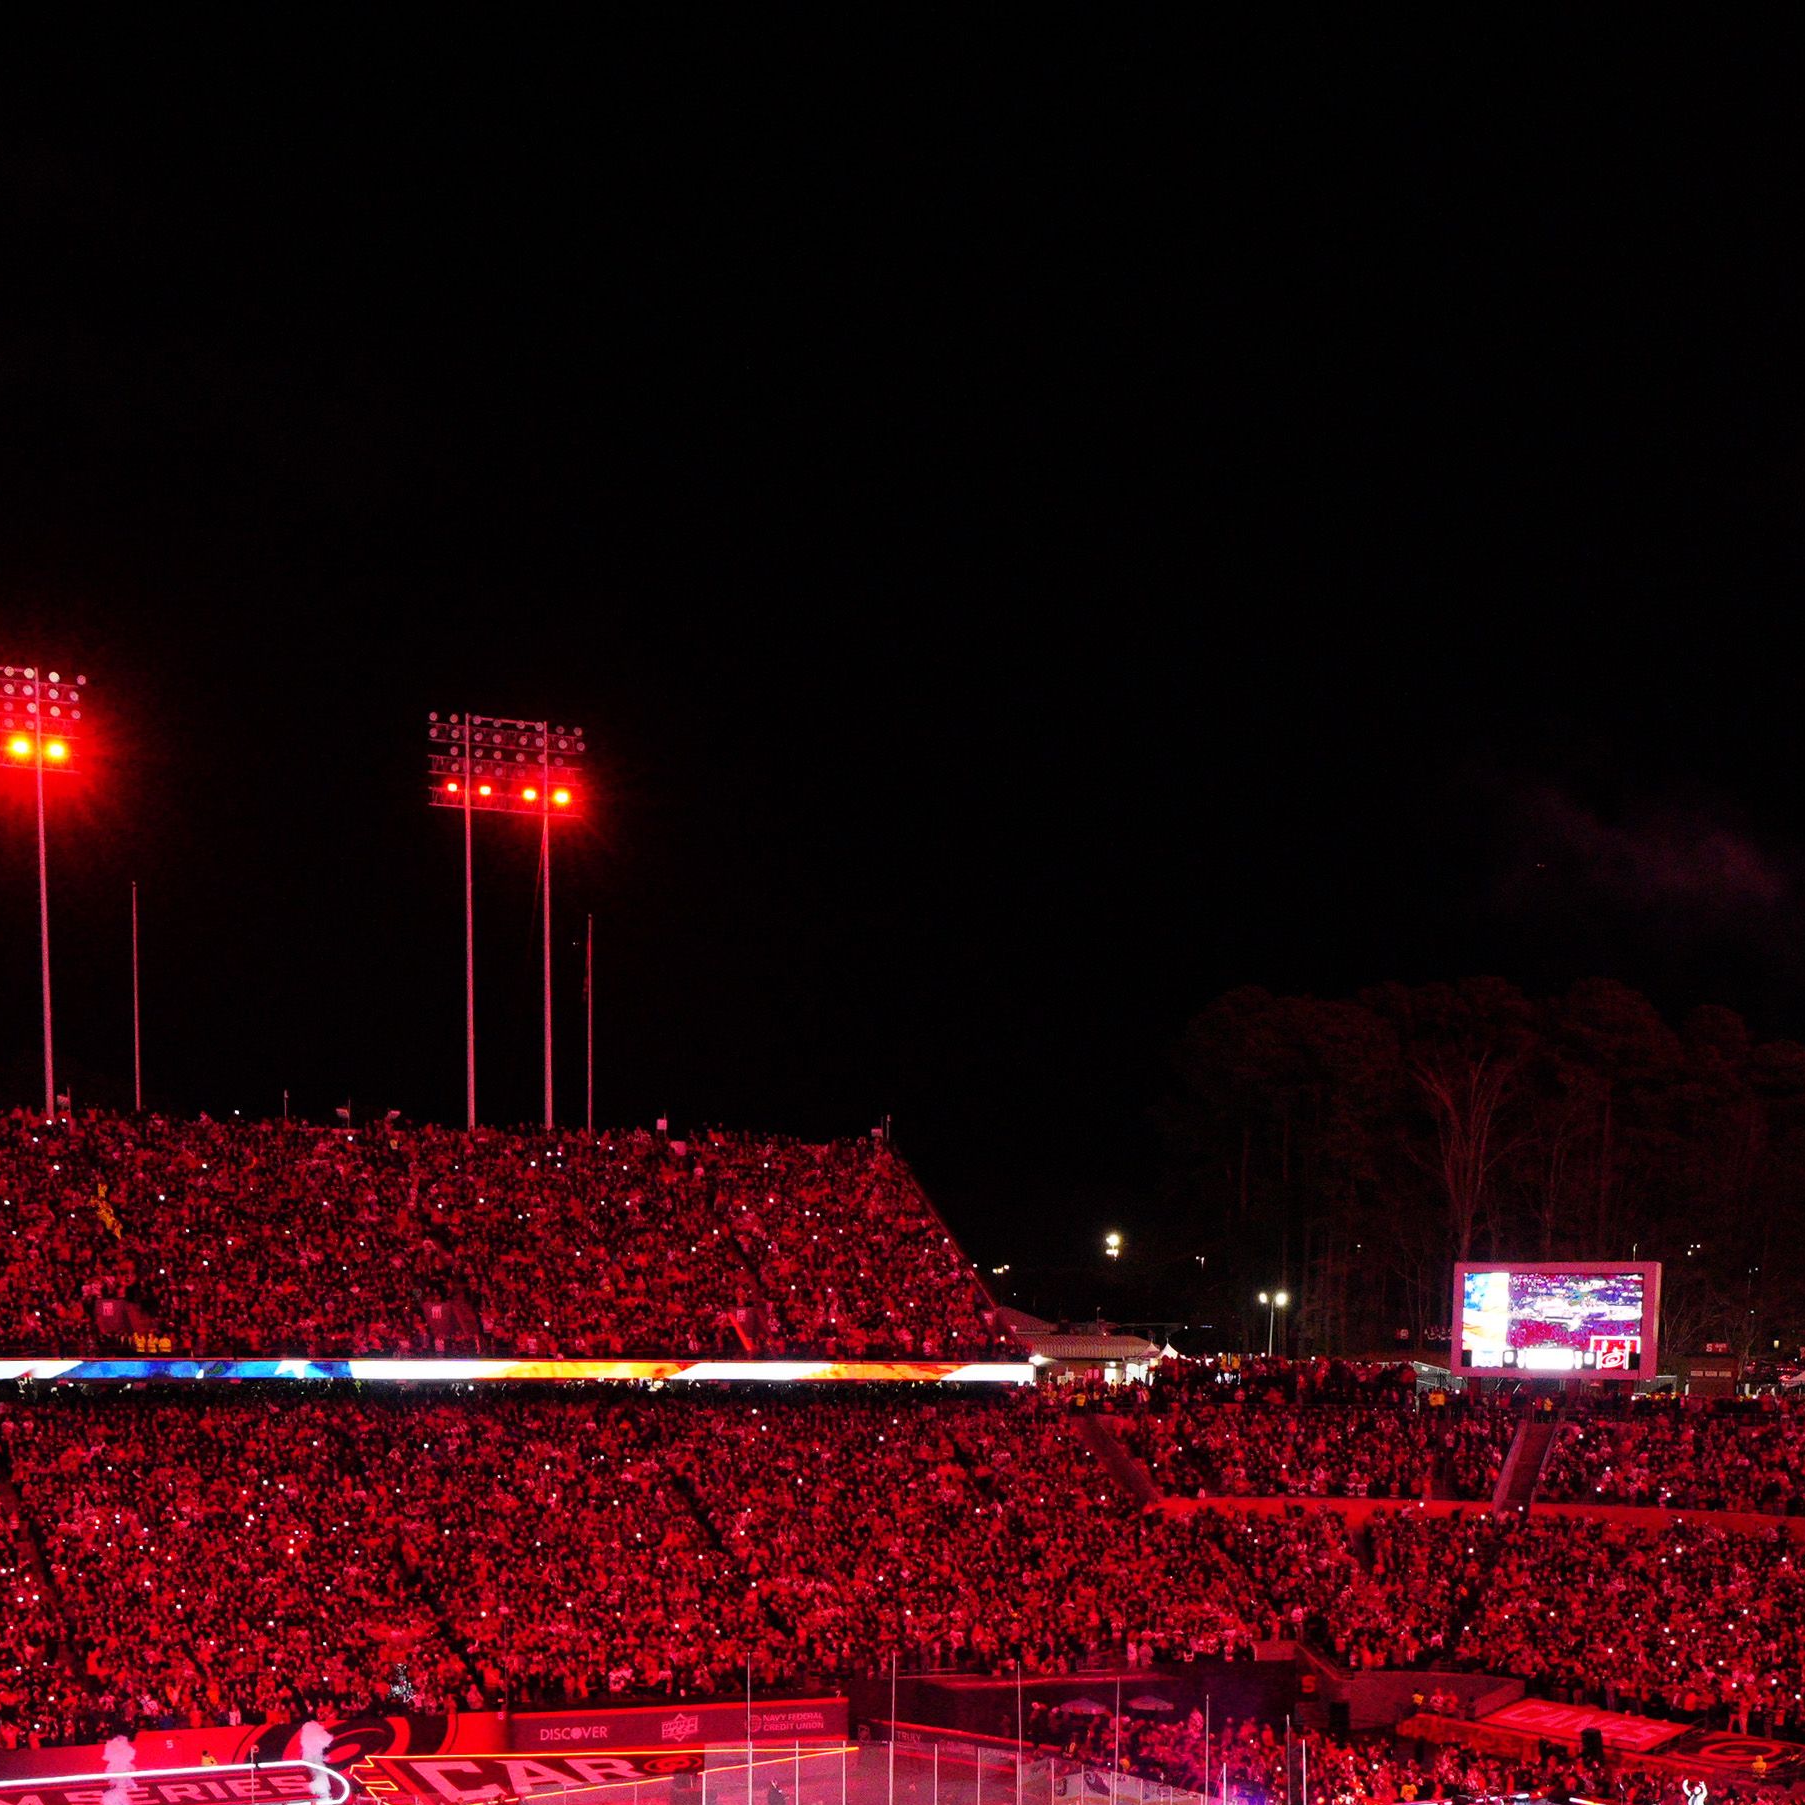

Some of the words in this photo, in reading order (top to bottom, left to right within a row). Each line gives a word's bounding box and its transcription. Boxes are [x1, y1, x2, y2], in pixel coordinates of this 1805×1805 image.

[789, 1712, 824, 1721] FEDERAL
[795, 1721, 824, 1730] UNION
[540, 1727, 608, 1741] DISCOVER
[165, 1739, 174, 1749] 5
[408, 1757, 644, 1802] CAR
